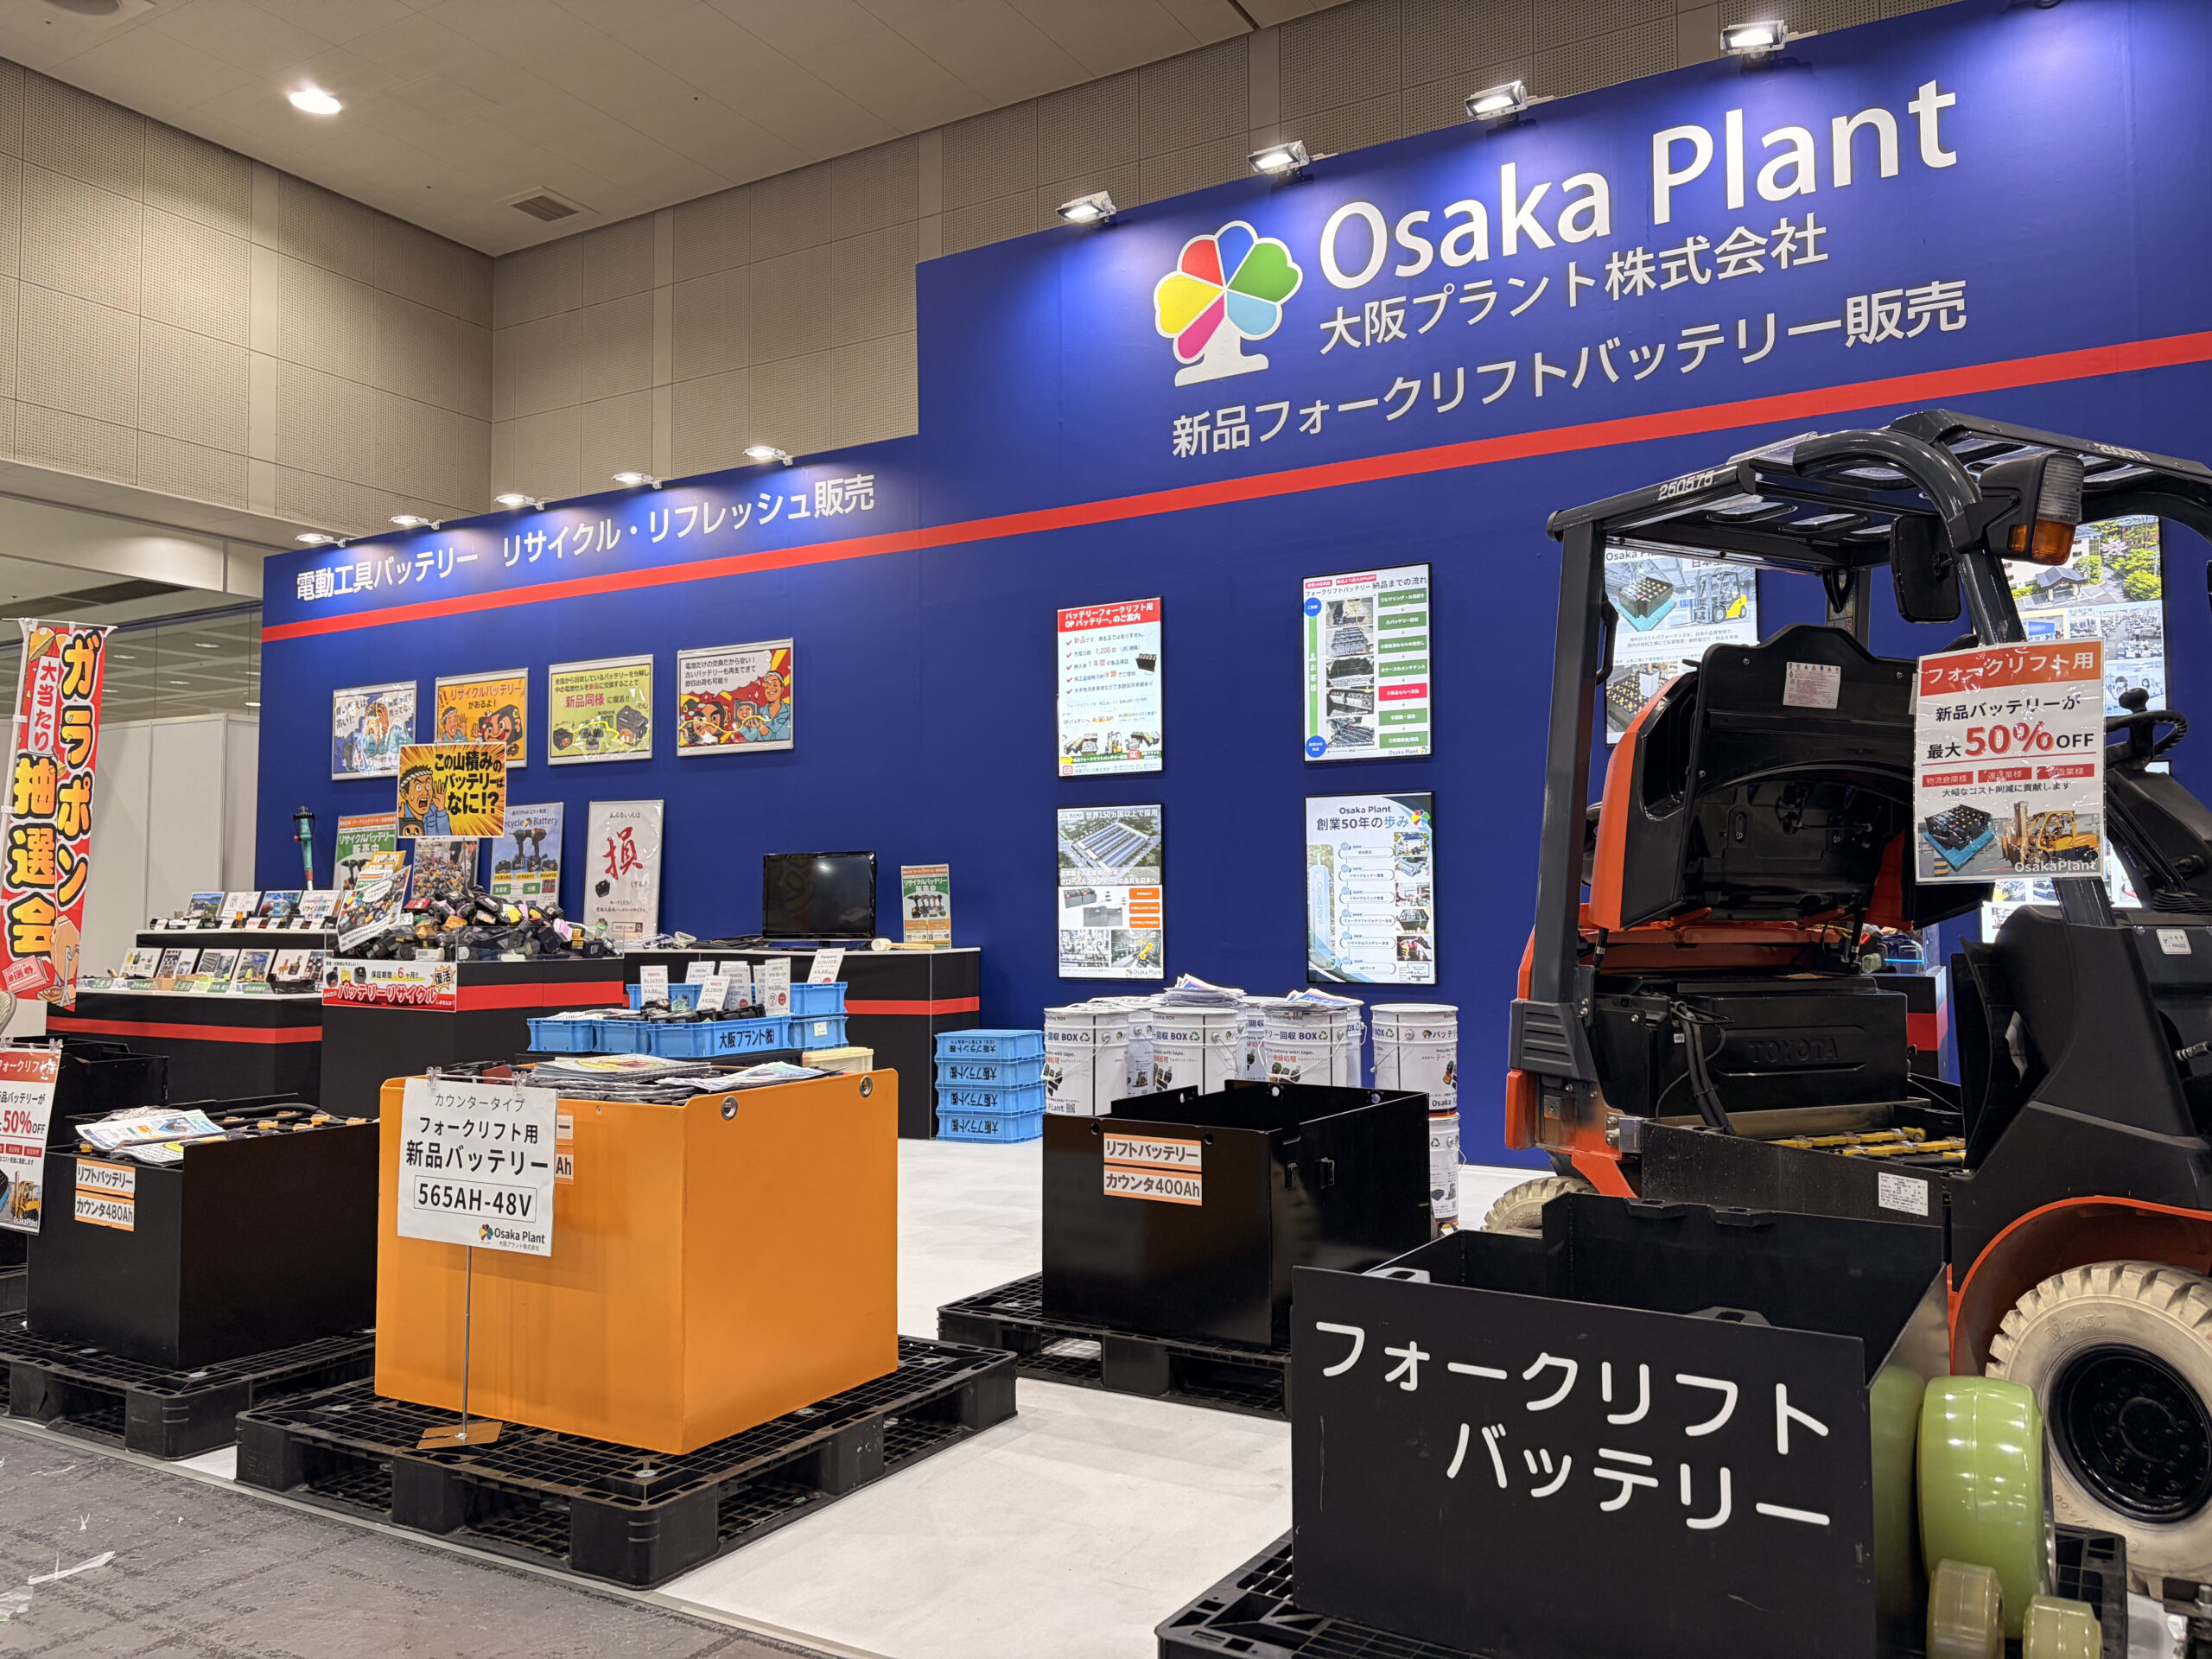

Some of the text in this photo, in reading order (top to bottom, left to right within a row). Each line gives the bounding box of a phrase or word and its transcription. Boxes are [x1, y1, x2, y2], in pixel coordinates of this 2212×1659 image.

[1319, 79, 1958, 291] Osaka Plant
[1319, 213, 1829, 356] 大阪プラント株式会社
[1172, 280, 1968, 460] 新品フォークリフトバッテリー販売
[1658, 470, 1715, 501] 250575
[297, 474, 875, 602] 電動工具バッテリー リサイクル・リフレッシュ販売
[1605, 550, 1637, 562] Osaka
[1306, 576, 1427, 597] フォークリフトバッテリー 納品までの流れ
[1065, 602, 1154, 620] バッテリーフォークリフト用
[685, 665, 756, 679] 古いバッテリーも再生できて
[1927, 652, 2094, 684] フォークリフト用
[450, 683, 522, 701] リサイクルバッテリー
[565, 693, 605, 709] 新品同様
[33, 664, 57, 753] 大当たり
[1935, 694, 2082, 723] 新品バッテリーが
[60, 634, 100, 909] ガラポン
[435, 750, 503, 773] この山積みの
[444, 772, 505, 791] バッテリーは
[1339, 805, 1392, 815] Osaka Plant
[504, 817, 559, 829] ecycle Battery
[1316, 815, 1410, 831] 創業50年の歩み
[339, 830, 395, 845] リサイクルバッテリー
[12, 756, 58, 957] 抽選会
[602, 826, 644, 880] 損
[2014, 859, 2097, 874] OsakaPlant
[903, 877, 948, 887] リサイクルバッテリー
[435, 970, 452, 985] 復活
[338, 983, 438, 1005] バッテリーリサイクル
[1061, 1033, 1078, 1041] BOX
[1170, 1033, 1188, 1041] BOX
[1299, 1031, 1318, 1040] BOX
[1749, 1038, 1840, 1064] TOYOTA
[435, 1093, 525, 1113] カウンタータイプ
[1432, 1098, 1452, 1107] Osaka
[420, 1116, 538, 1145] フォークリフト用
[406, 1139, 549, 1176] 新品バッテリー
[1107, 1141, 1198, 1162] リフトバッテリー
[78, 1166, 133, 1188] リフトバッテリー
[1106, 1173, 1200, 1198] カウンタ400Ah
[418, 1182, 532, 1217] 565AH-48V
[76, 1198, 133, 1223] カウンタ480Ah
[494, 1227, 546, 1245] Osaka Plant
[499, 1240, 540, 1252] 大阪プラント株式会社
[1316, 1321, 1829, 1455] フォークリフト
[1446, 1422, 1831, 1529] バッテリー
